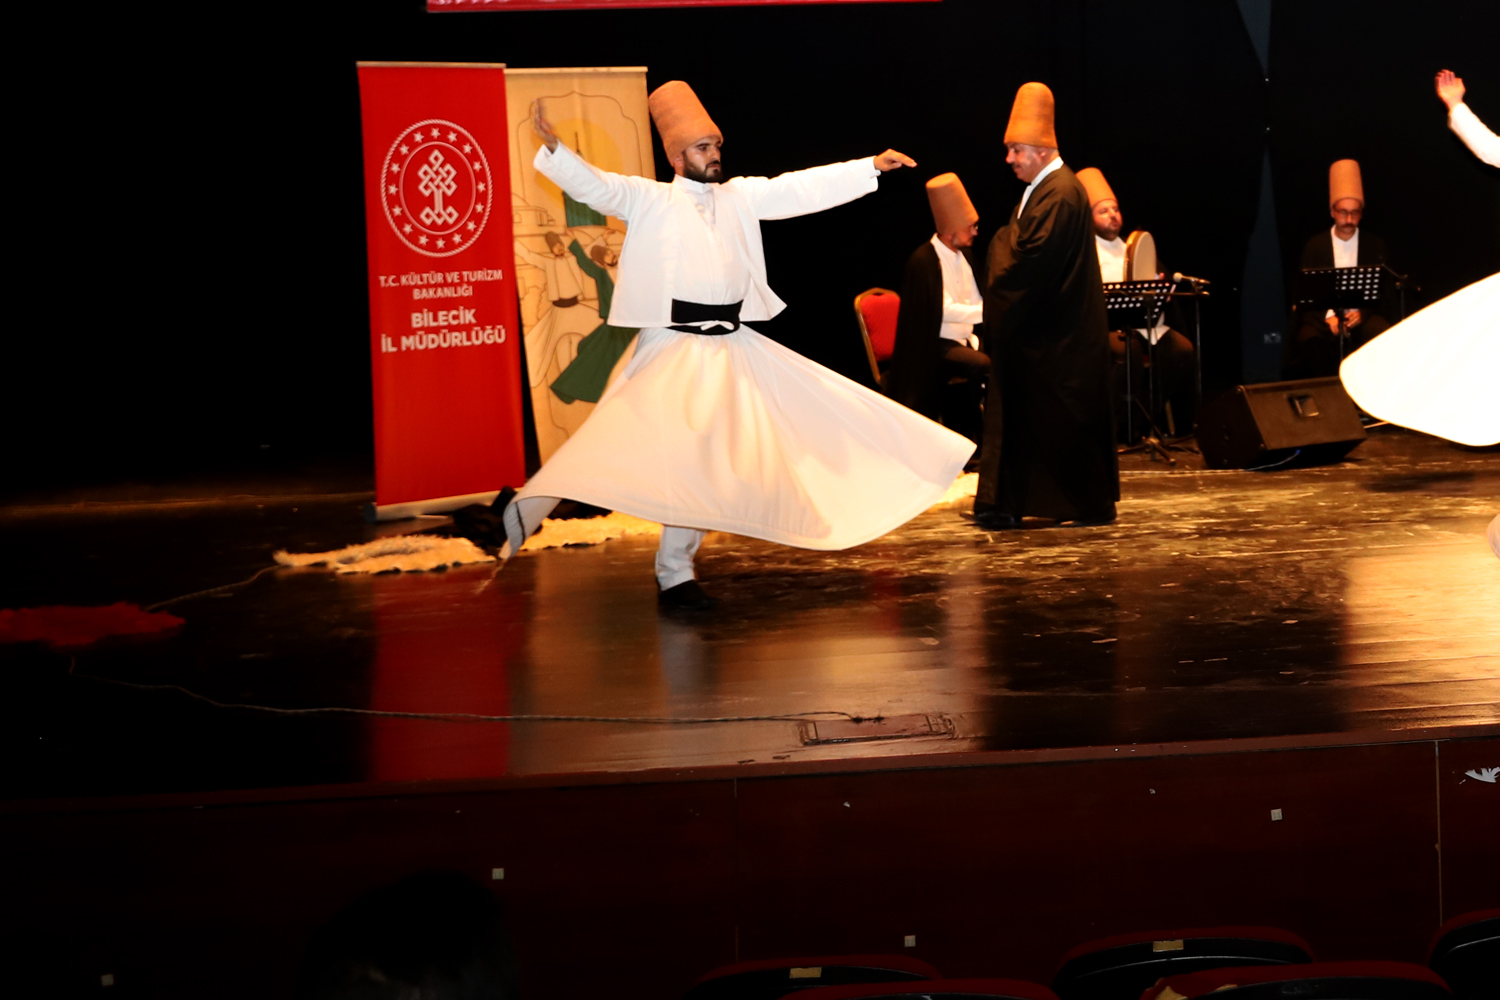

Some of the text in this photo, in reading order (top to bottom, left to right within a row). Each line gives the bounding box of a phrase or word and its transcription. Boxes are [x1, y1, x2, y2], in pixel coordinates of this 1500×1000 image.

[379, 268, 503, 287] T.C. KÜLTÜR VE TURİZM
[413, 283, 473, 300] BAKANLIĞI
[411, 306, 477, 328] BİLECİK
[381, 325, 506, 353] İL MÜDÜRLÜĞÜ
